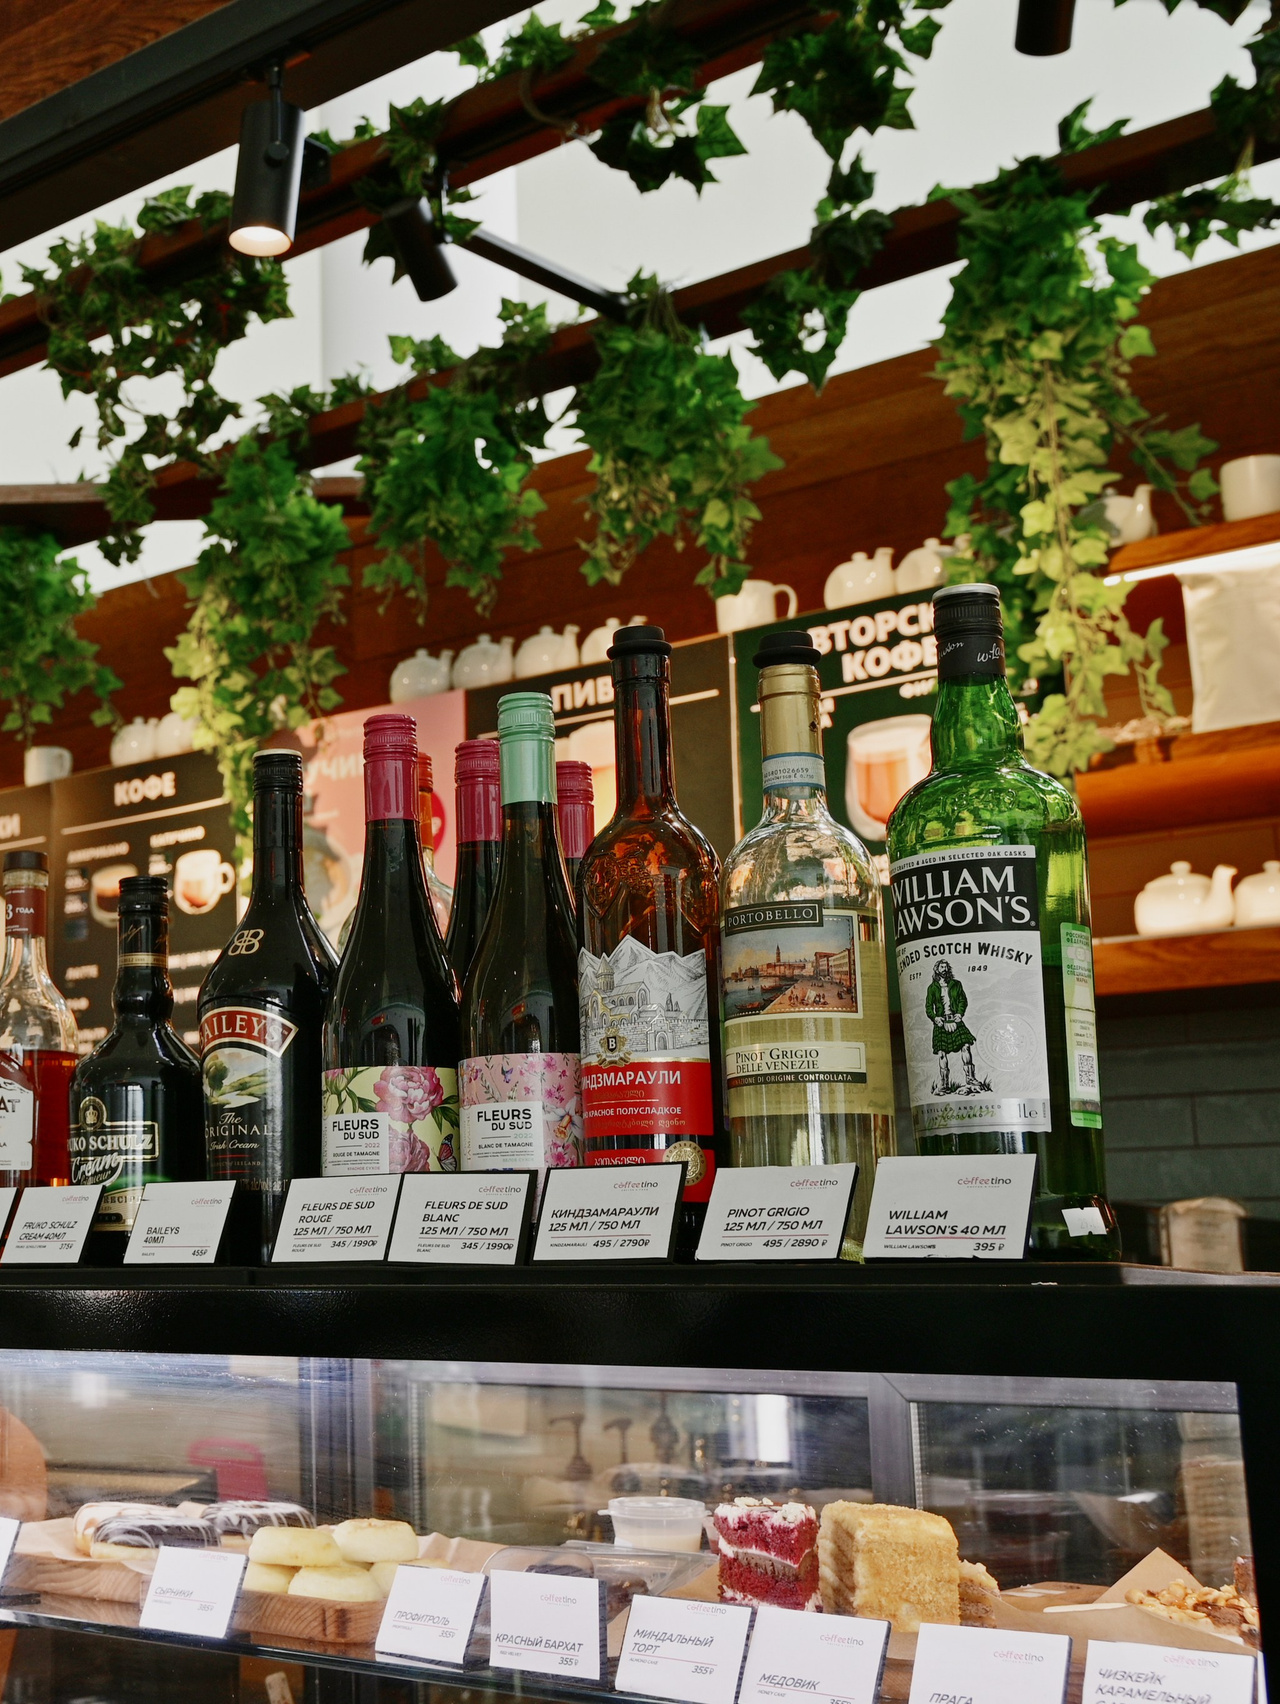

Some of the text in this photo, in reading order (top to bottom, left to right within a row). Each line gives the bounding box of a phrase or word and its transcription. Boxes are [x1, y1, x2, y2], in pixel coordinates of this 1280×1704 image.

[114, 771, 176, 806] КОФЕ
[948, 852, 984, 860] SELECTED
[891, 866, 1015, 908] WILLIAM
[728, 908, 813, 927] PORTOBELLO
[924, 942, 971, 958] SCOTCH
[978, 942, 1033, 965] WHISKY
[736, 1048, 819, 1064] PINOT GRIGIO
[736, 1060, 819, 1074] DELLE VENEZIE
[582, 1070, 681, 1090] ИНДЗМАРАУЛИ
[798, 1073, 852, 1081] CONTROLLATA
[477, 1109, 532, 1122] FLEURS
[589, 1107, 681, 1117] КРАСНОЕ ПОЛУСЛАДКОЕ
[219, 1112, 243, 1124] The
[333, 1119, 379, 1131] FLEURS
[491, 1121, 533, 1131] DU SUD
[205, 1125, 273, 1138] ORIGINAL
[344, 1131, 380, 1140] DU SUD
[89, 1134, 153, 1150] SCHULZ
[229, 1139, 259, 1149] Cream
[301, 1201, 375, 1211] FLEURS DE SUD
[425, 1201, 508, 1210] FLEURS DE SUD
[422, 1214, 460, 1222] BLANC
[551, 1207, 659, 1219] КИНДЗАМАРАУЛИ
[727, 1207, 810, 1218] PINOT GRIGIO
[889, 1210, 948, 1220] WILLIAM
[298, 1215, 333, 1223] ROUGE
[22, 1221, 78, 1229] FRUKO SCHULZ
[146, 1226, 180, 1235] BAILEYS
[293, 1225, 372, 1236] 125 МЛ 750 МЛ
[548, 1220, 641, 1231] 125 МЛ 750 МЛ
[723, 1220, 823, 1231] 125 МЛ 750 МЛ
[885, 1225, 1006, 1235] LAWSON'S 40 МЛ
[18, 1232, 44, 1240] CREAM
[420, 1227, 508, 1236] 125 МЛ 750 МЛ
[143, 1235, 165, 1244] 40МЛ
[763, 1239, 819, 1247] 495 2890
[461, 1242, 479, 1250] 345
[973, 1242, 996, 1251] 395
[155, 1587, 193, 1598] СЫРНИКИ
[394, 1610, 450, 1625] ПРОФИТРОЛЬ
[495, 1633, 583, 1653] КРАСНЫЙ БАРХАТ
[633, 1628, 714, 1648] МИНДАЛЬНЫЙ
[631, 1642, 661, 1654] ТОРТ
[759, 1673, 820, 1691] МЕДОВИК
[1097, 1667, 1166, 1686] ЧИЗКЕЙК
